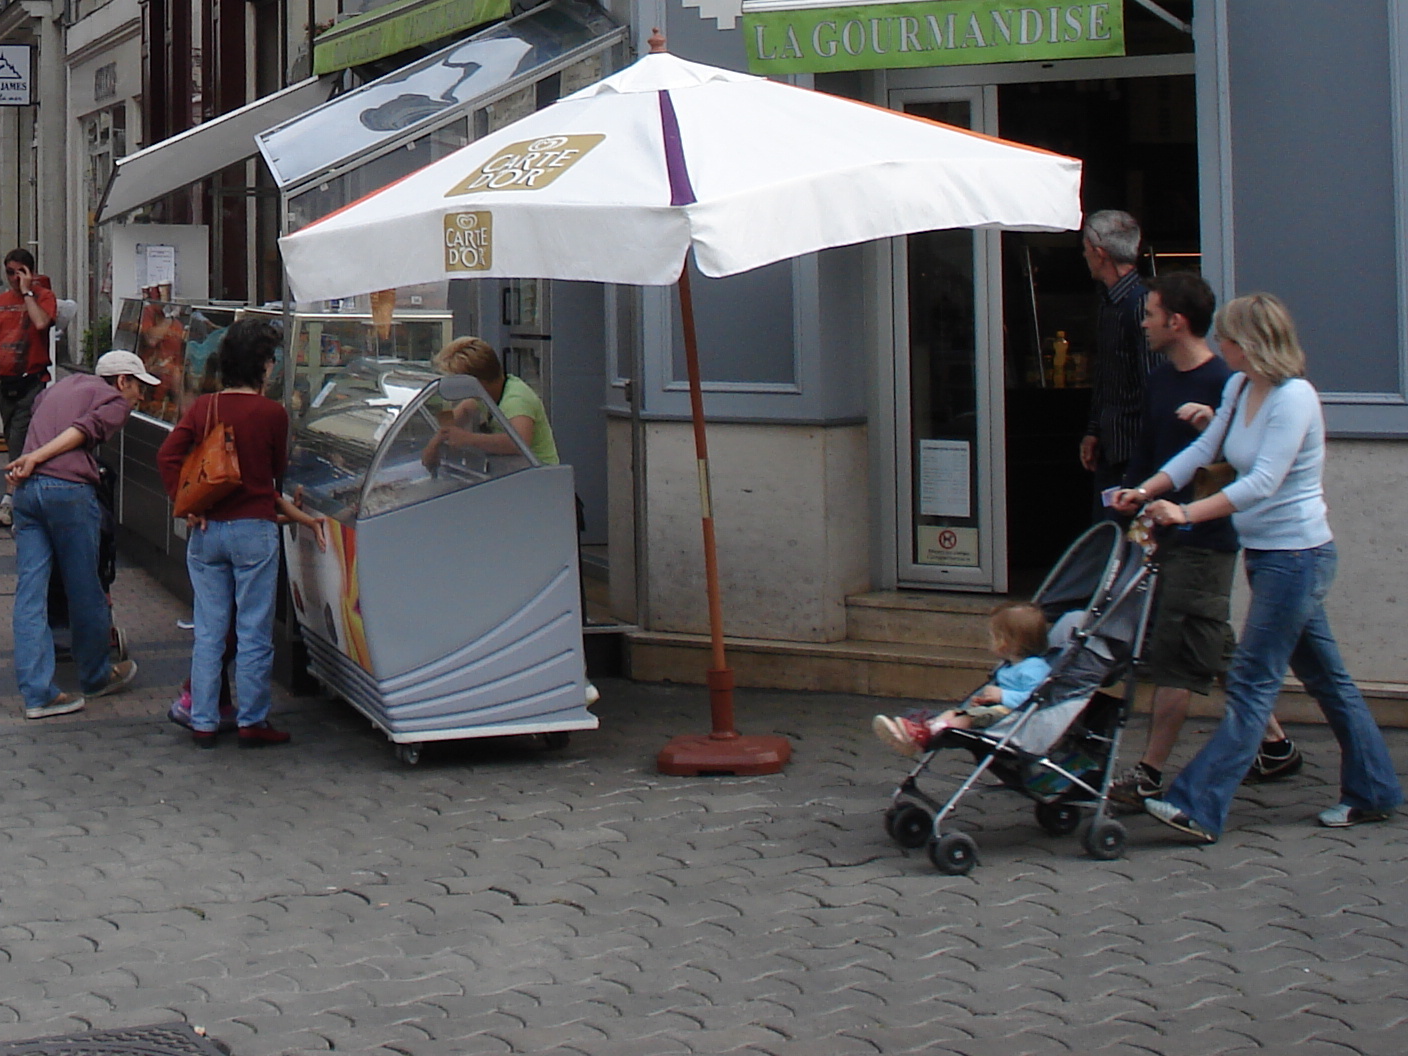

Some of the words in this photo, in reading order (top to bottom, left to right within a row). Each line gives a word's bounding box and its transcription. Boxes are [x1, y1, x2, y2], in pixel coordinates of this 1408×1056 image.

[755, 23, 805, 61] LA
[811, 2, 1112, 57] GOURMANDISE
[0, 81, 28, 91] JAMES
[481, 149, 580, 175] CARTE
[445, 227, 489, 249] CARTE
[449, 245, 486, 268] D'OR
